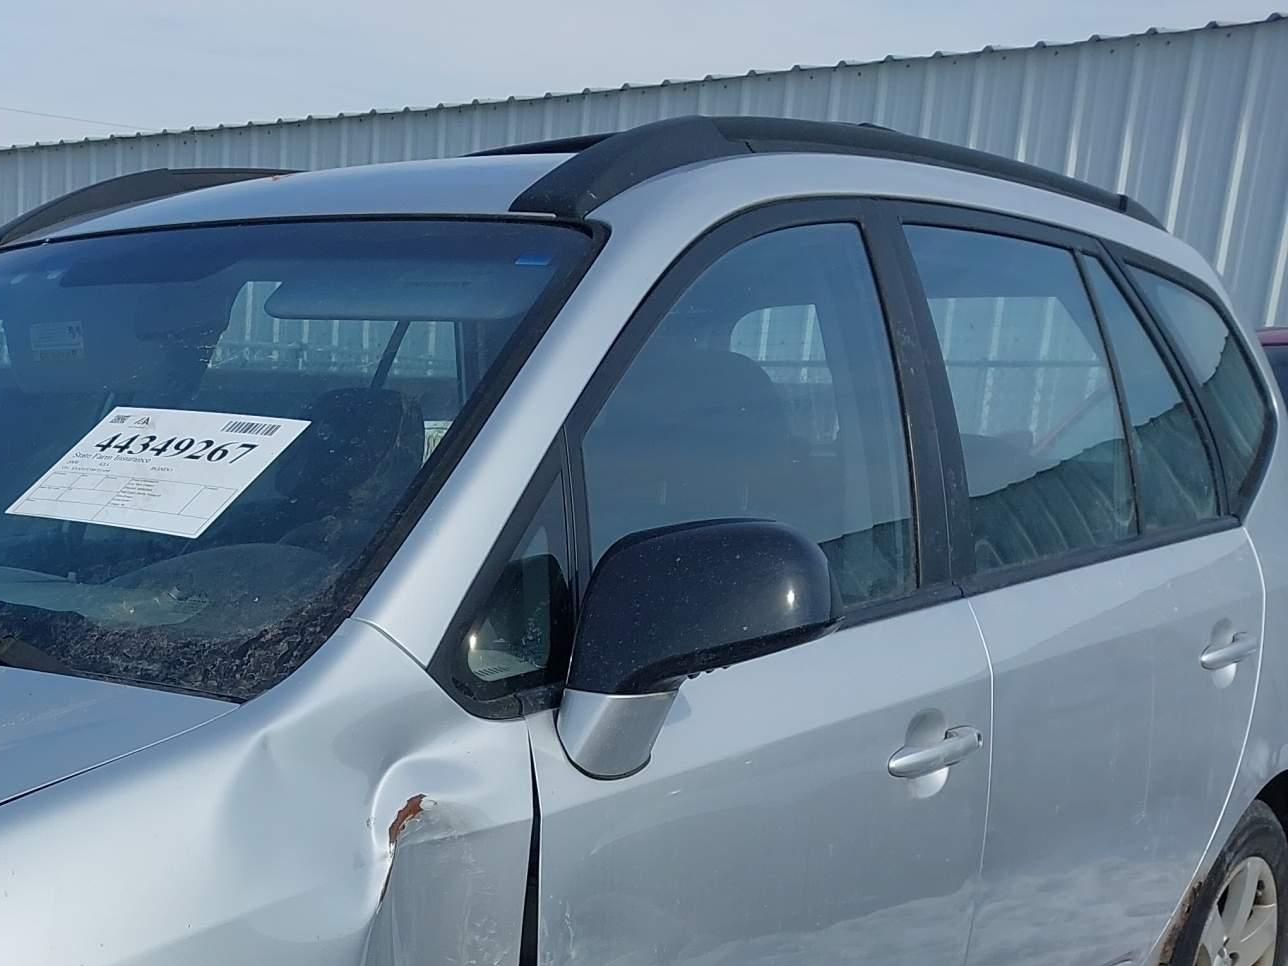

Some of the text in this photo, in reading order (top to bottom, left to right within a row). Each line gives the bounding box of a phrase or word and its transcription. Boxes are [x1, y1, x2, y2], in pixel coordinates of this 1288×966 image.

[72, 452, 152, 464] State Farm Insurance
[94, 432, 259, 464] 44349267
